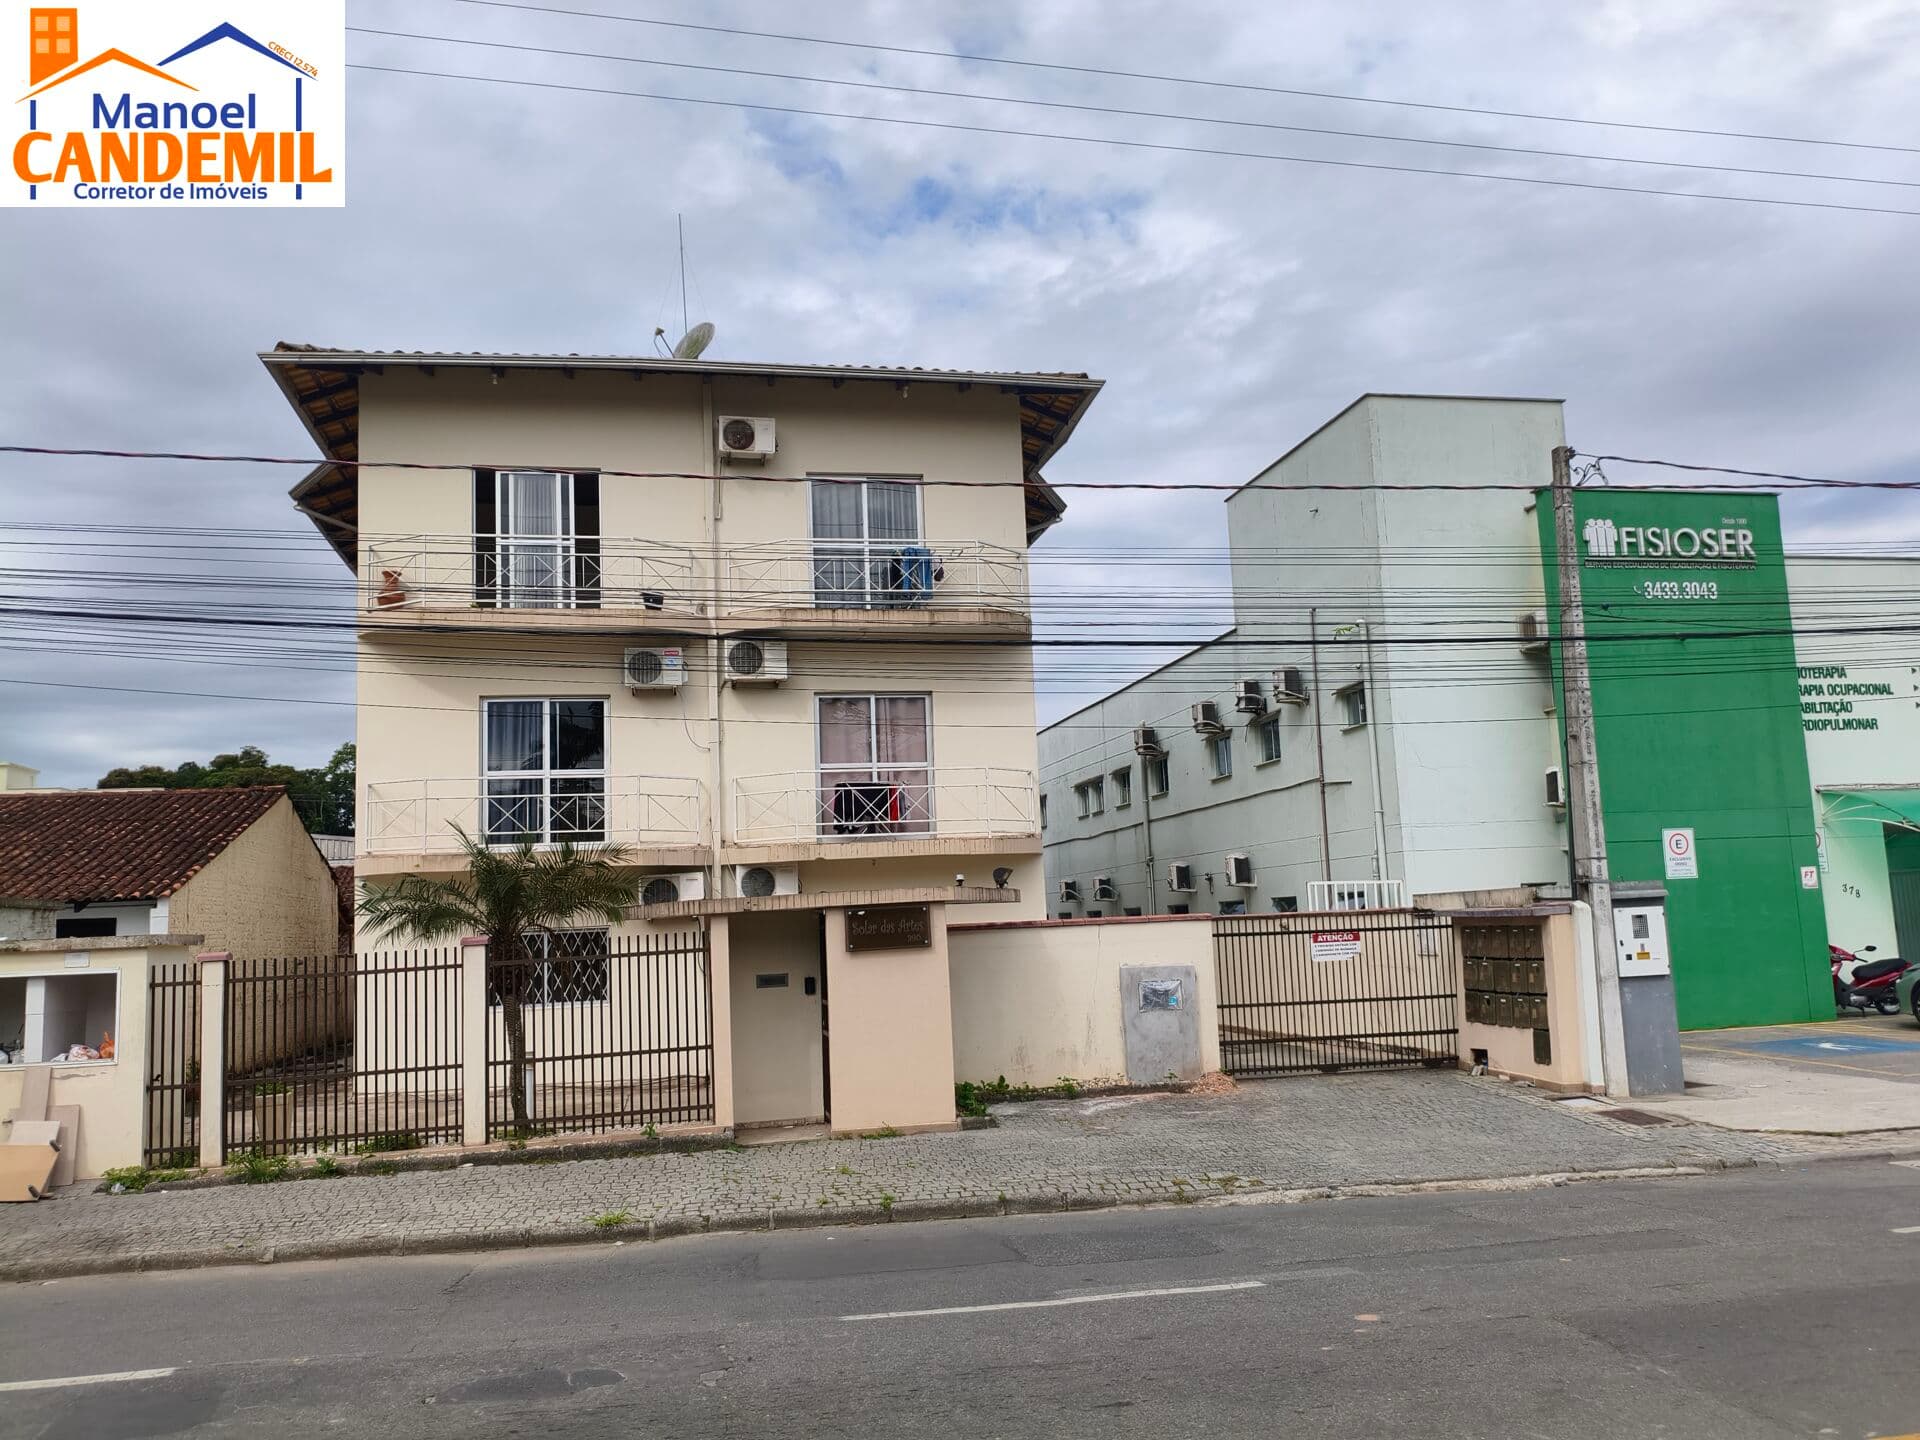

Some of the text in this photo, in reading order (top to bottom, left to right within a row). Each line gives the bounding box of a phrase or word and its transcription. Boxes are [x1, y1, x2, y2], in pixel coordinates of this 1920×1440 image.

[1618, 527, 1756, 557] FISIOSER
[1644, 581, 1718, 600] 3433.3043
[1827, 683, 1894, 696] OCUPACIONAL
[1675, 839, 1683, 849] E
[1842, 883, 1861, 898] 378
[1318, 933, 1354, 942] ATENÇÃO
